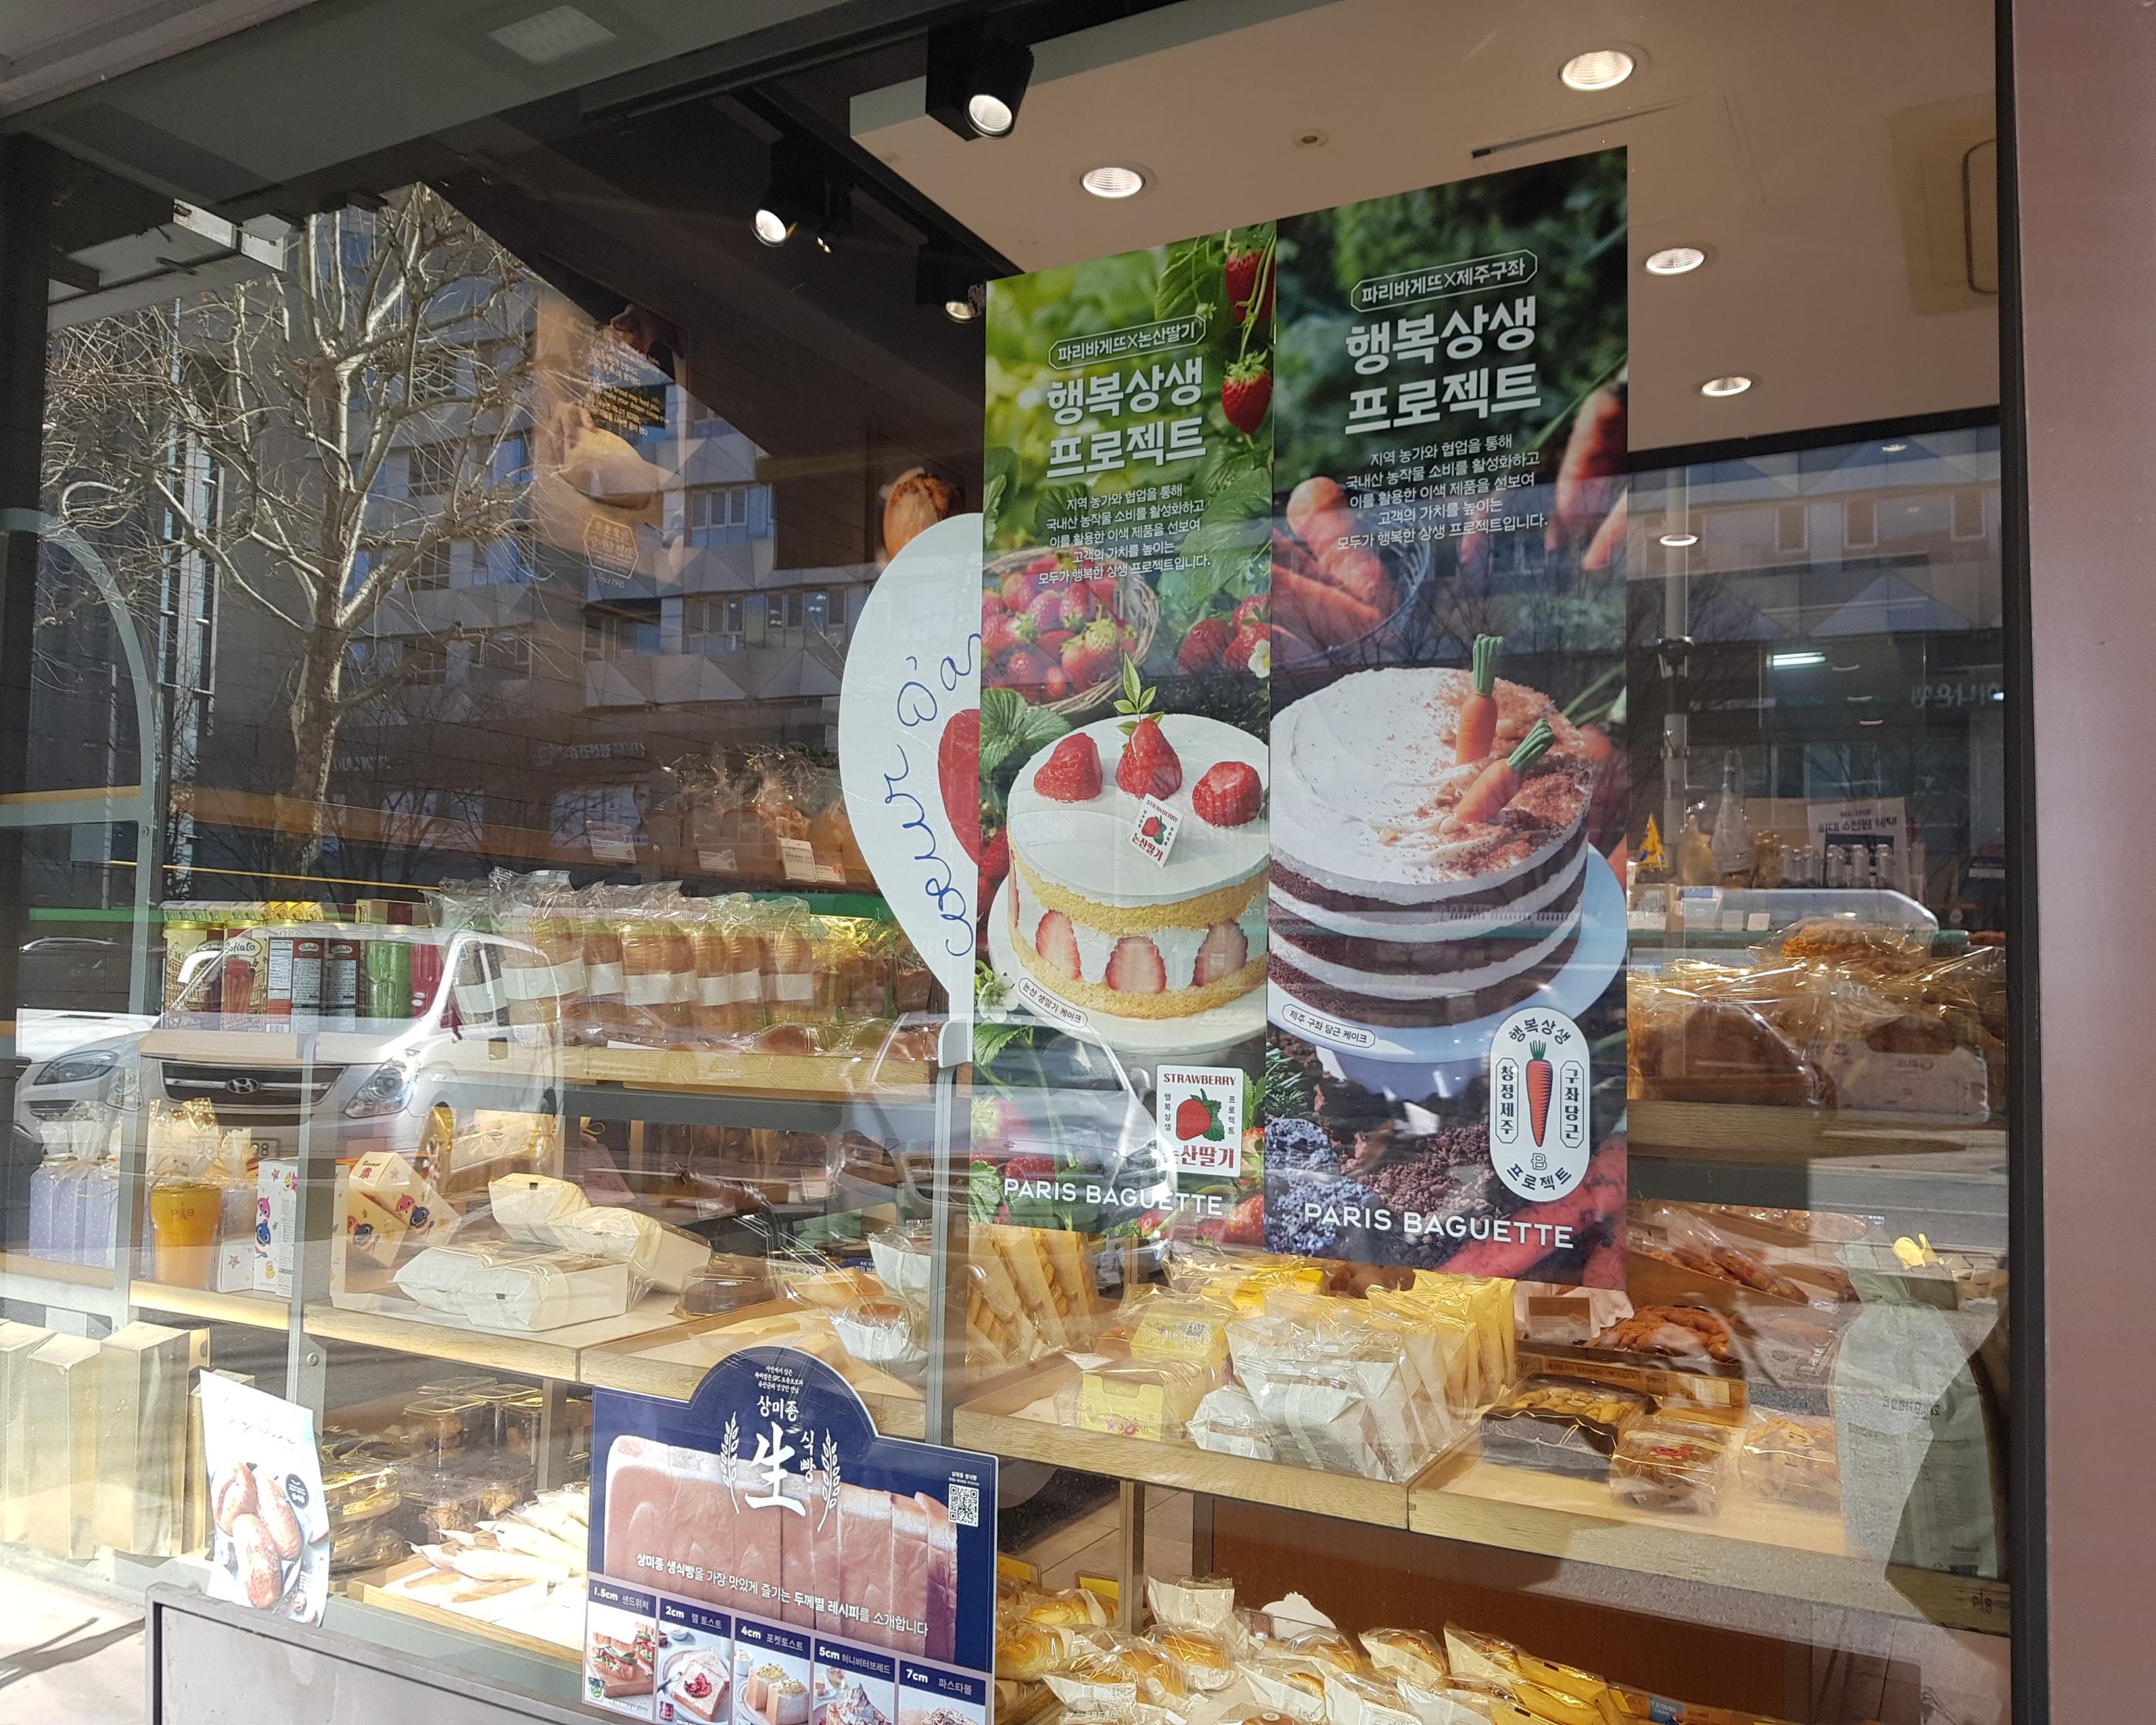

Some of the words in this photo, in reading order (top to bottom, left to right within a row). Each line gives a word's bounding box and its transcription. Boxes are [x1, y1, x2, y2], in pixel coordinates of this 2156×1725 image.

[1346, 295, 1536, 375] 행복상생
[1047, 357, 1203, 424] 행복상생
[1345, 363, 1541, 434] 프로젝트
[1047, 417, 1207, 478] 프로젝트
[1371, 451, 1395, 467] 지역
[1399, 444, 1438, 464] 농가와
[1441, 437, 1481, 458] 협업을
[1485, 434, 1512, 451] 통해
[1345, 471, 1384, 491] 국내산
[1387, 466, 1425, 486] 농작물
[1428, 461, 1468, 480] 소비를
[1471, 451, 1540, 474] 활성화하고
[1067, 497, 1087, 511] 지역
[1090, 493, 1122, 509] 농가와
[1125, 487, 1157, 504] 협업을
[1160, 483, 1183, 500] 통해
[1350, 493, 1375, 510] 이를
[1378, 487, 1417, 506] 활용한
[1420, 483, 1446, 500] 이색
[1449, 478, 1490, 496] 제품을
[1494, 472, 1535, 491] 선보여
[1046, 517, 1078, 532] 국내산
[1080, 511, 1112, 528] 농작물
[1114, 507, 1147, 524] 소비를
[1149, 500, 1205, 519] 활성화하고
[1378, 507, 1415, 525] 고객의
[1420, 502, 1459, 520] 가치를
[1462, 497, 1503, 516] 높이는
[1050, 534, 1071, 549] 이를
[1073, 531, 1105, 546] 활용한
[1107, 525, 1129, 542] 이색
[1132, 523, 1164, 539] 제품을
[1167, 518, 1200, 534] 선보여
[1337, 533, 1374, 551] 모두가
[1378, 528, 1415, 547] 행복한
[1419, 523, 1445, 541] 상생
[1448, 513, 1548, 537] 프로젝트입니다.
[1073, 548, 1104, 564] 고객의
[1107, 543, 1140, 560] 가치를
[1142, 541, 1175, 557] 높이는
[1038, 570, 1070, 585] 모두가
[1073, 566, 1104, 582] 행복한
[1106, 563, 1128, 579] 상생
[1130, 554, 1210, 574] 프로젝트입니다.
[1147, 799, 1179, 823] STRAWBERRY
[1132, 832, 1163, 862] 논산딸기
[1023, 983, 1037, 997] 논산
[1038, 994, 1059, 1013] 생딸기
[1060, 1007, 1081, 1023] 케이크
[1290, 1010, 1305, 1023] 제주
[1307, 1017, 1323, 1031] 구좌
[1325, 1024, 1341, 1037] 당근
[1342, 1030, 1367, 1043] 케이크
[1509, 1017, 1572, 1045] 행복상생
[1163, 1073, 1237, 1086] STRAWBERRY
[1163, 1092, 1172, 1131] 행복상생
[1227, 1096, 1236, 1134] 프로젝트
[1500, 1065, 1515, 1135] 청정제주
[1565, 1068, 1580, 1139] 구좌당근
[1507, 1164, 1572, 1191] 프로젝트
[1004, 1178, 1076, 1202] PARIS
[1086, 1184, 1223, 1215] BAGUETTE
[1304, 1203, 1392, 1231] PARIS
[1404, 1212, 1574, 1248] BAGUETTE
[757, 1395, 799, 1422] 상미종
[744, 1421, 806, 1517] 生
[800, 1429, 817, 1483] 식빵
[594, 1586, 618, 1601] 1.5cm
[622, 1595, 648, 1610] 샌드위치
[636, 1552, 664, 1571] 상미종
[667, 1559, 705, 1581] 생식빵을
[707, 1570, 726, 1587] 가장
[729, 1576, 758, 1596] 맛있게
[761, 1583, 792, 1603] 즐기는
[794, 1592, 825, 1612] 두께별
[828, 1600, 870, 1623] 레시피를
[872, 1613, 929, 1637] 소개합니다
[665, 1606, 685, 1619] 2cm
[700, 1616, 721, 1630] 토스트
[741, 1626, 762, 1640] 4cm
[766, 1633, 803, 1651] 포켓토스트
[819, 1646, 840, 1660] 5cm
[842, 1655, 892, 1674] 허니버터브레드
[906, 1668, 929, 1683] 7cm
